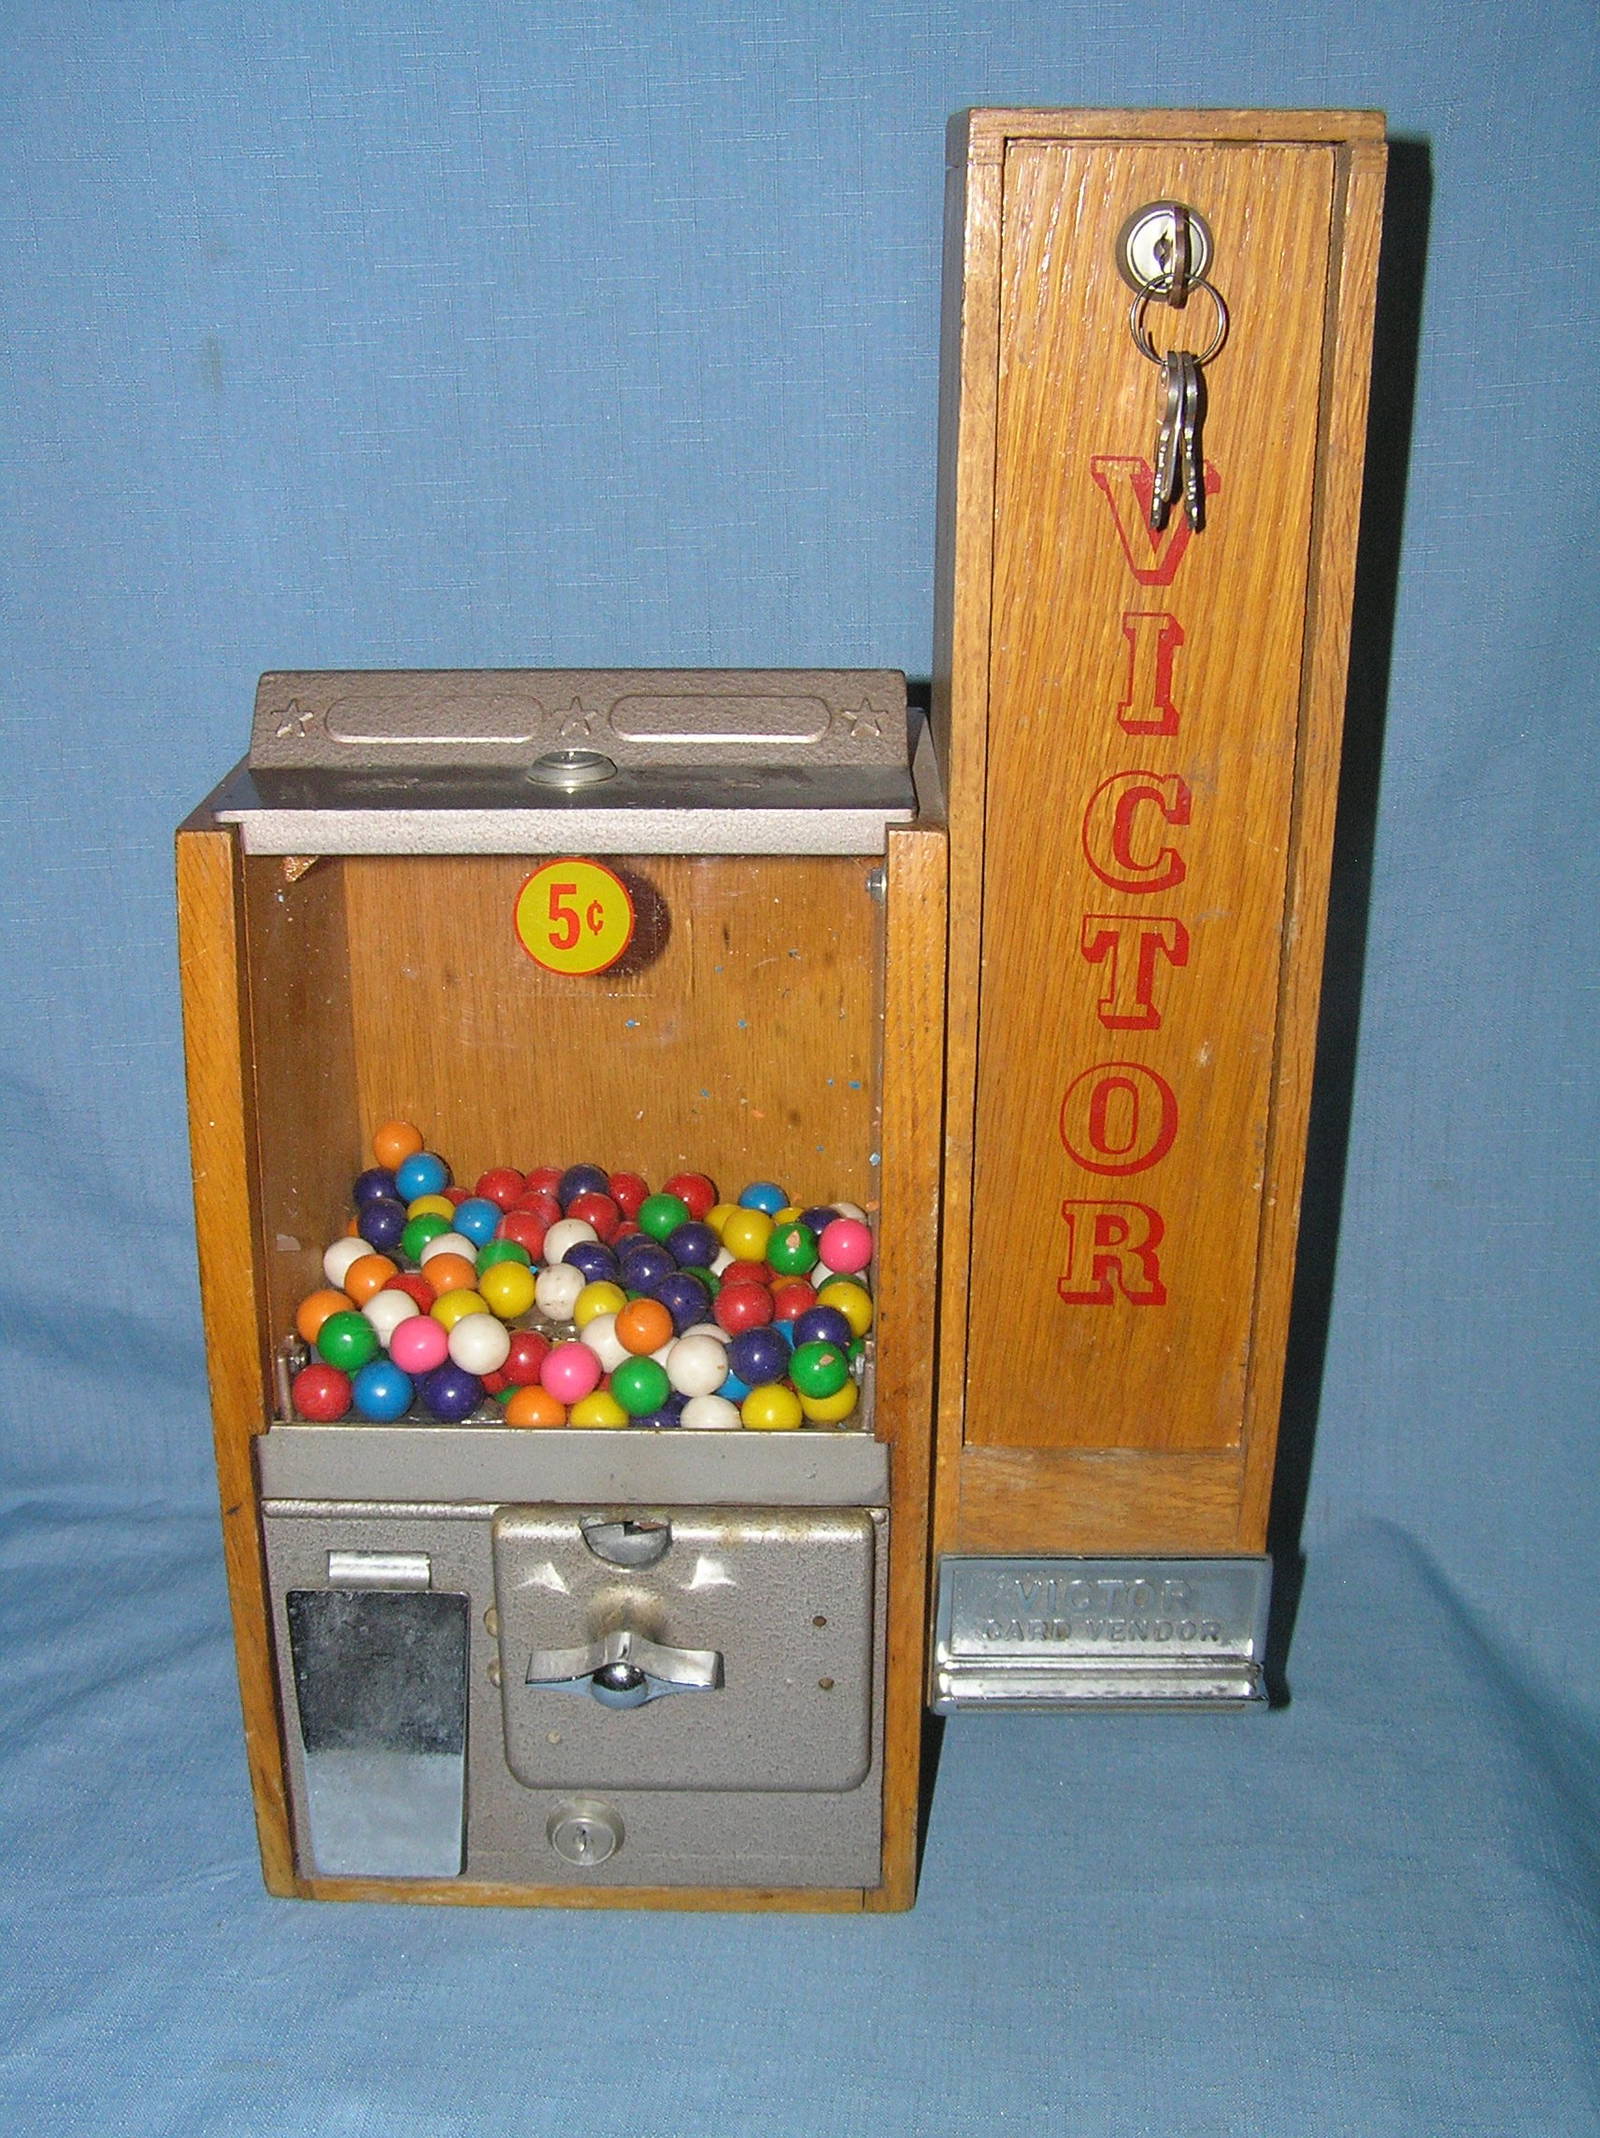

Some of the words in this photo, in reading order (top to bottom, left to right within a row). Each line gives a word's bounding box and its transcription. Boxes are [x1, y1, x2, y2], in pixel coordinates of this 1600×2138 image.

[1057, 456, 1221, 1305] VICTOR
[548, 883, 604, 951] 5¢
[1013, 1578, 1195, 1613] VICTOR
[981, 1618, 1073, 1642] CARD
[1085, 1618, 1222, 1643] VENDOR
